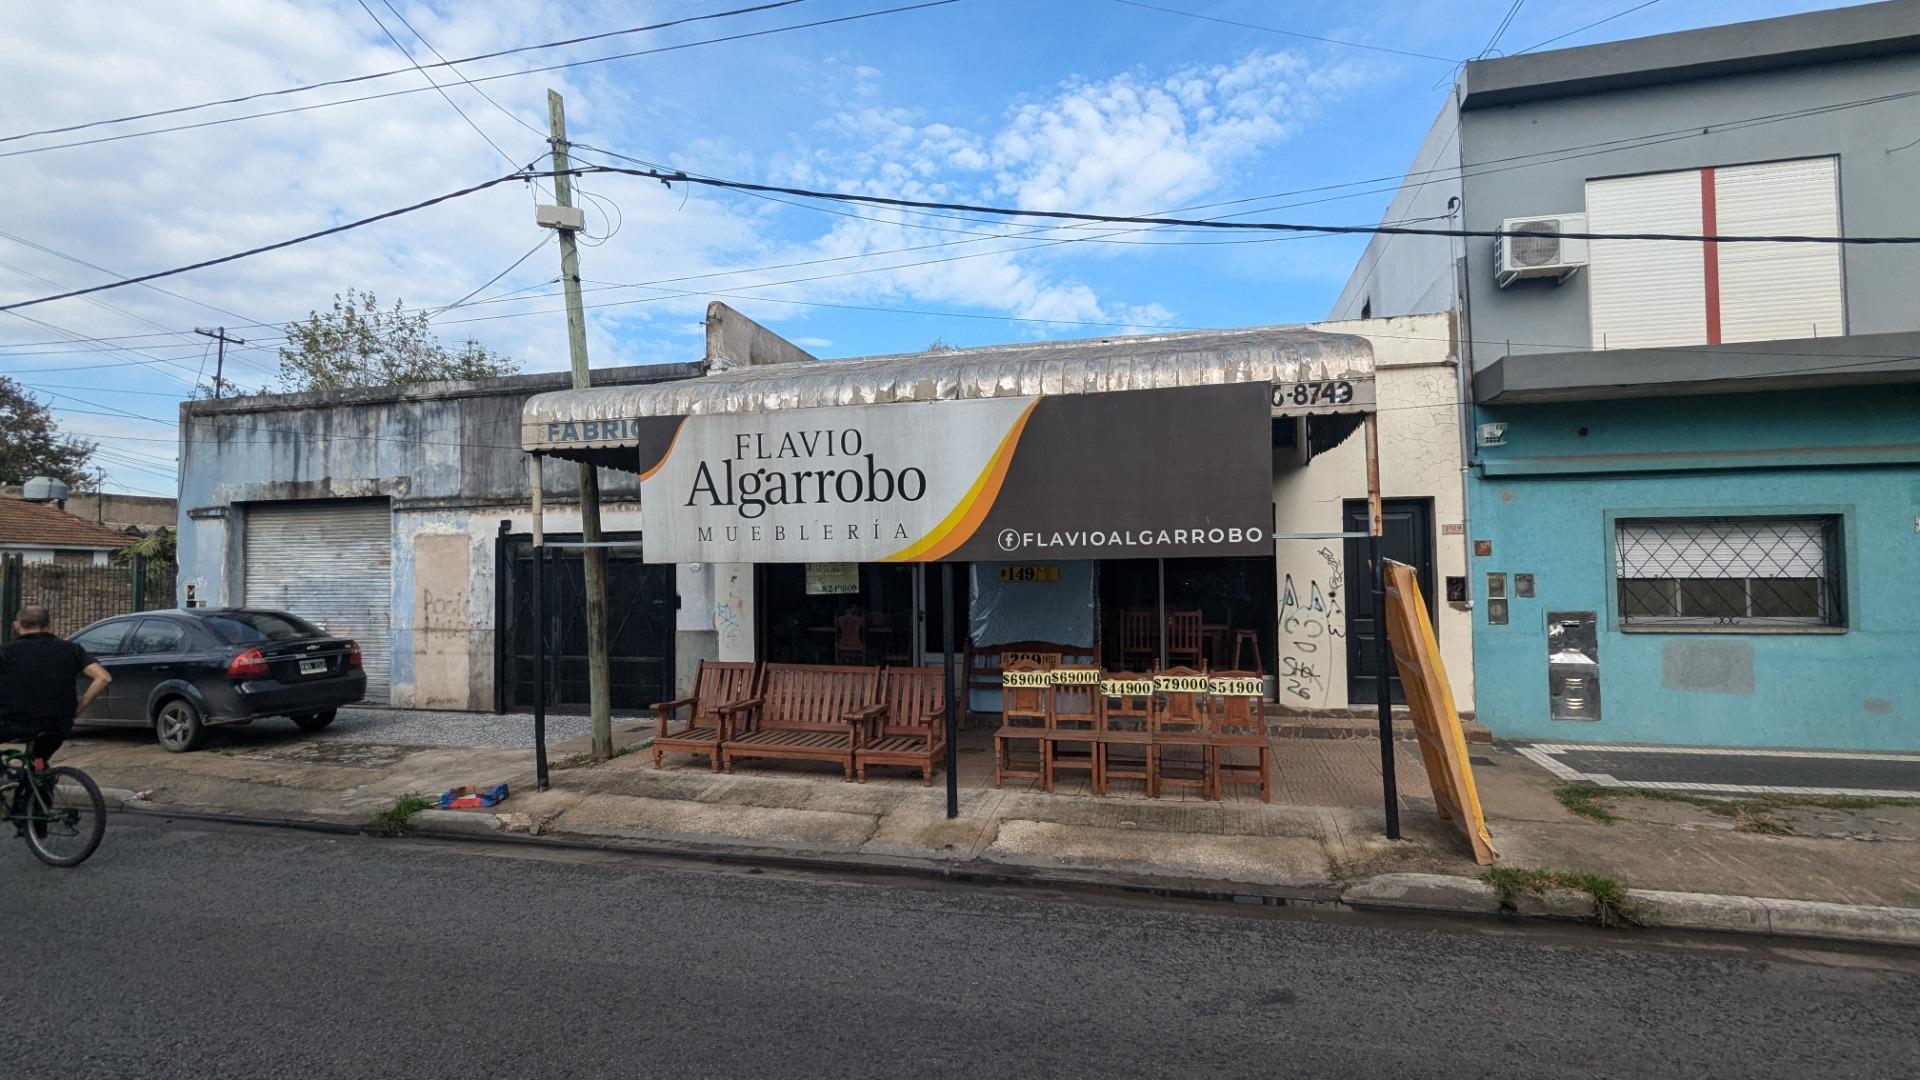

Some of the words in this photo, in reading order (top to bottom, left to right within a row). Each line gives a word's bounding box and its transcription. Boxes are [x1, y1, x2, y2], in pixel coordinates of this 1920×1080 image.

[734, 428, 862, 460] FLAVIO
[683, 453, 927, 519] Algarrobo
[697, 518, 909, 542] MUEBLERÍA
[1023, 527, 1263, 547] FLAVIOALGARROBO
[1003, 673, 1051, 686] $69000
[1051, 671, 1100, 684] $69000
[1153, 677, 1208, 690] $79000
[1101, 682, 1150, 694] $44900
